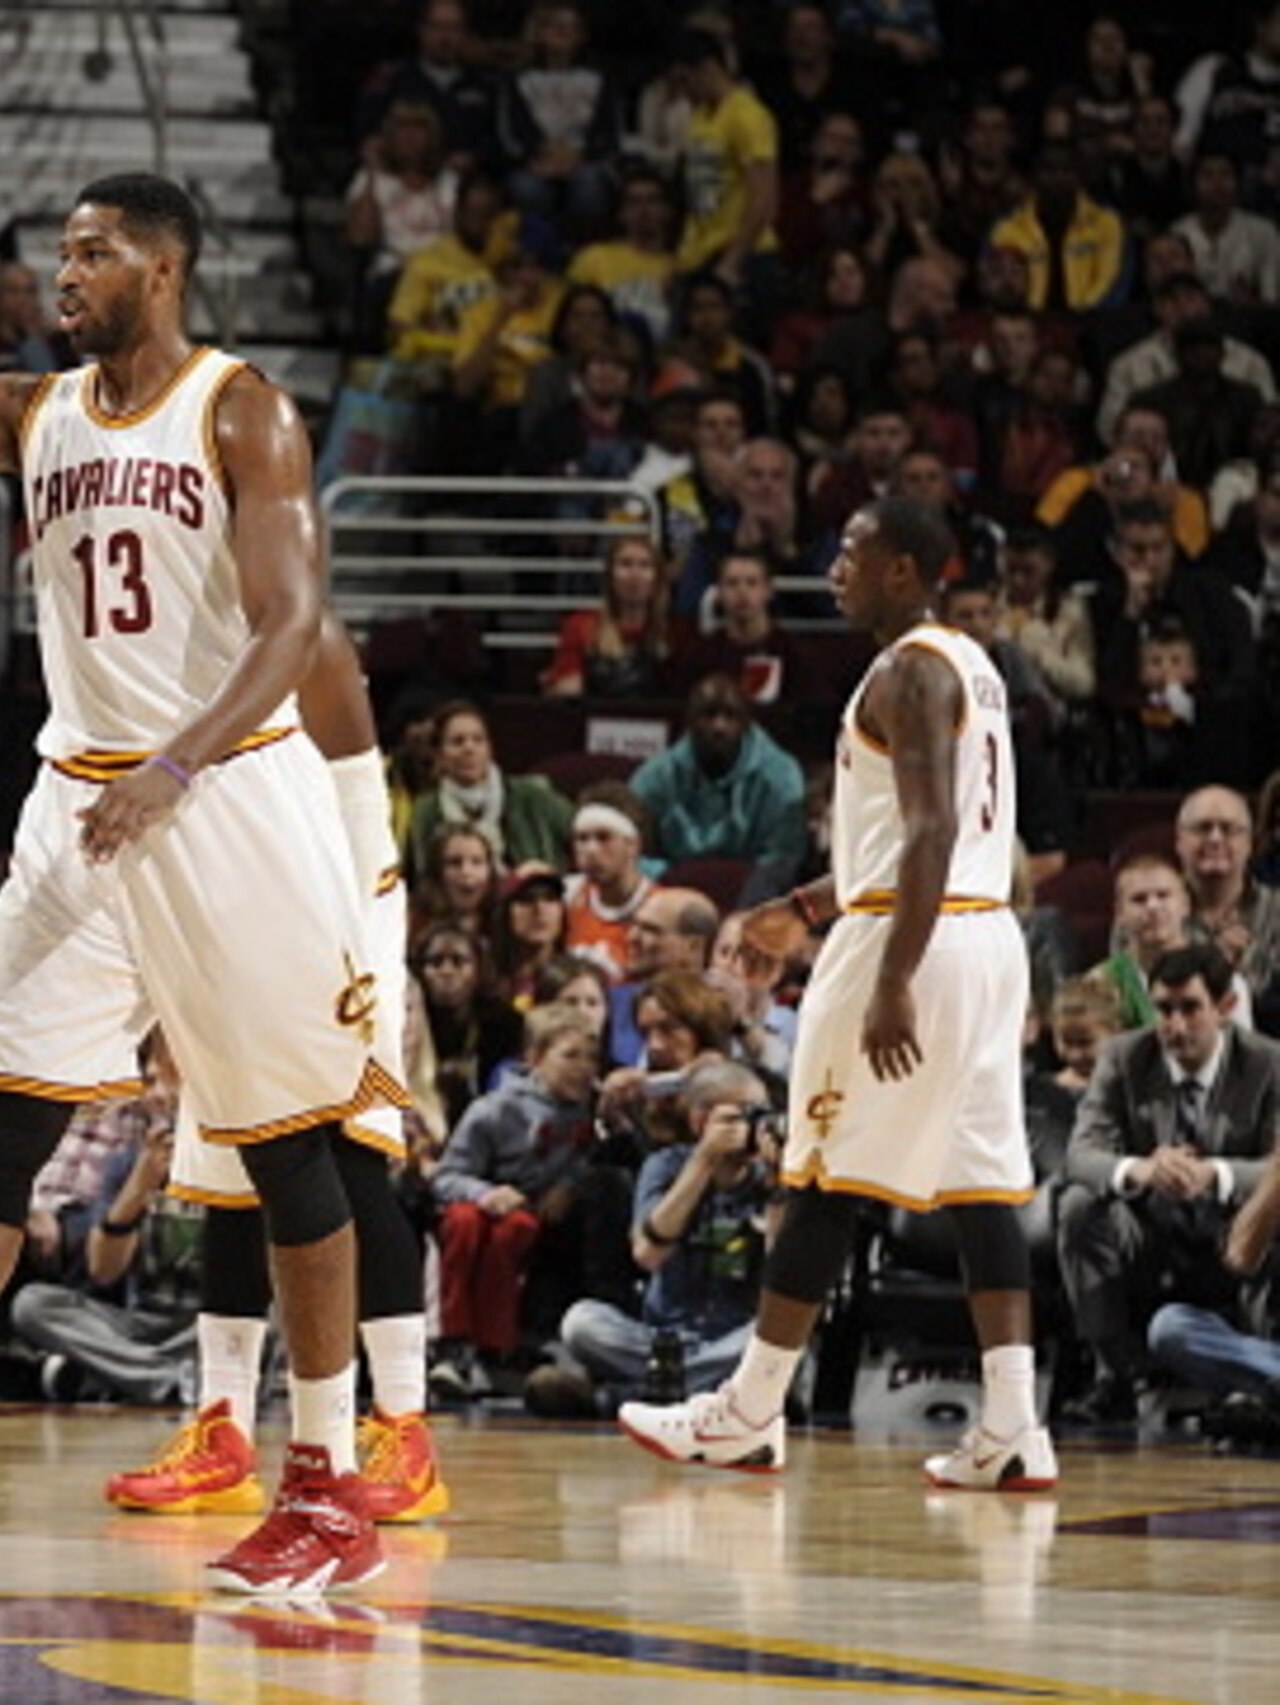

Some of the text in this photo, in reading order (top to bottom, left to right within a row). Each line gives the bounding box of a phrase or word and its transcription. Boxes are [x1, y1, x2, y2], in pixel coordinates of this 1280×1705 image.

[33, 457, 205, 541] CAVALIERS
[72, 528, 153, 639] 13
[980, 730, 999, 833] 3
